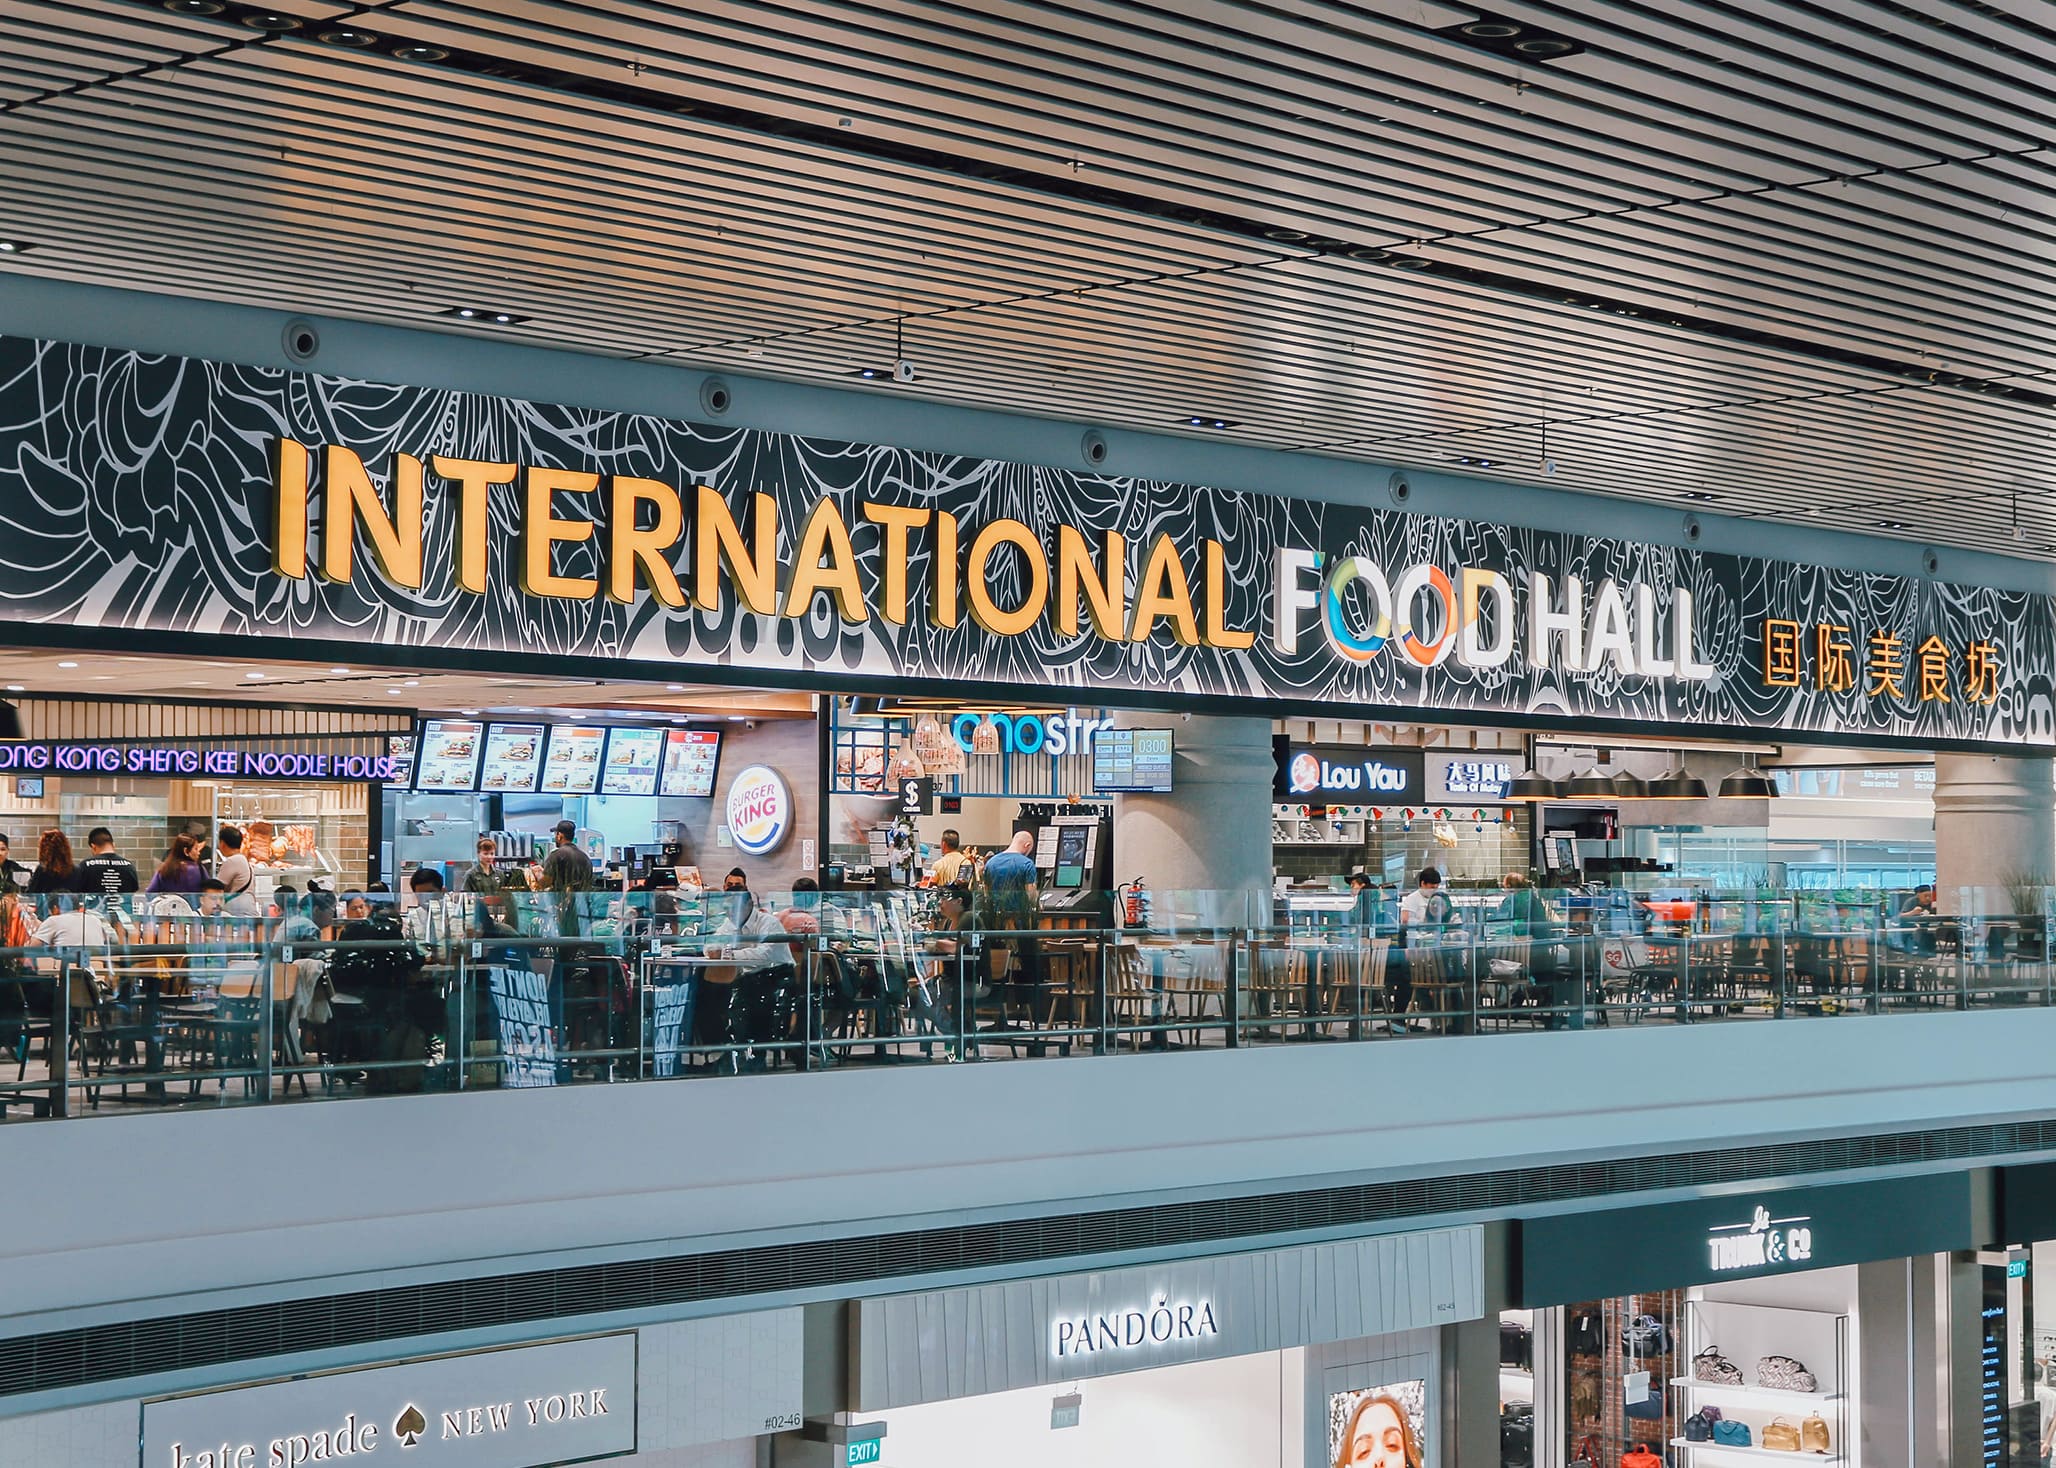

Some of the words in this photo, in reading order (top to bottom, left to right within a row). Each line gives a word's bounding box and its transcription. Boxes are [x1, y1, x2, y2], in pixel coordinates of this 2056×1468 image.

[272, 437, 1254, 649] INTERNATIONAL
[1273, 547, 1514, 667] FOOD
[1528, 571, 1714, 680] HALL
[1763, 618, 1998, 705] 国际美食坊
[953, 707, 1113, 755] onostr
[55, 746, 120, 771] KONG
[127, 750, 198, 773] SHENG
[205, 751, 238, 774] KEE
[245, 753, 327, 777] NOODLE
[334, 756, 397, 778] HOUSE
[1321, 760, 1360, 789] Lou
[733, 784, 775, 812] BURGER
[735, 797, 776, 831] KING
[2008, 1263, 2022, 1277] EXIT
[1058, 1295, 1218, 1356] PANDORA
[171, 1443, 256, 1468] kate
[269, 1414, 378, 1468] spade
[440, 1402, 512, 1440] NEW
[524, 1388, 608, 1427] YORK
[764, 1412, 801, 1429] #02-46
[848, 1443, 873, 1462] EXIT
